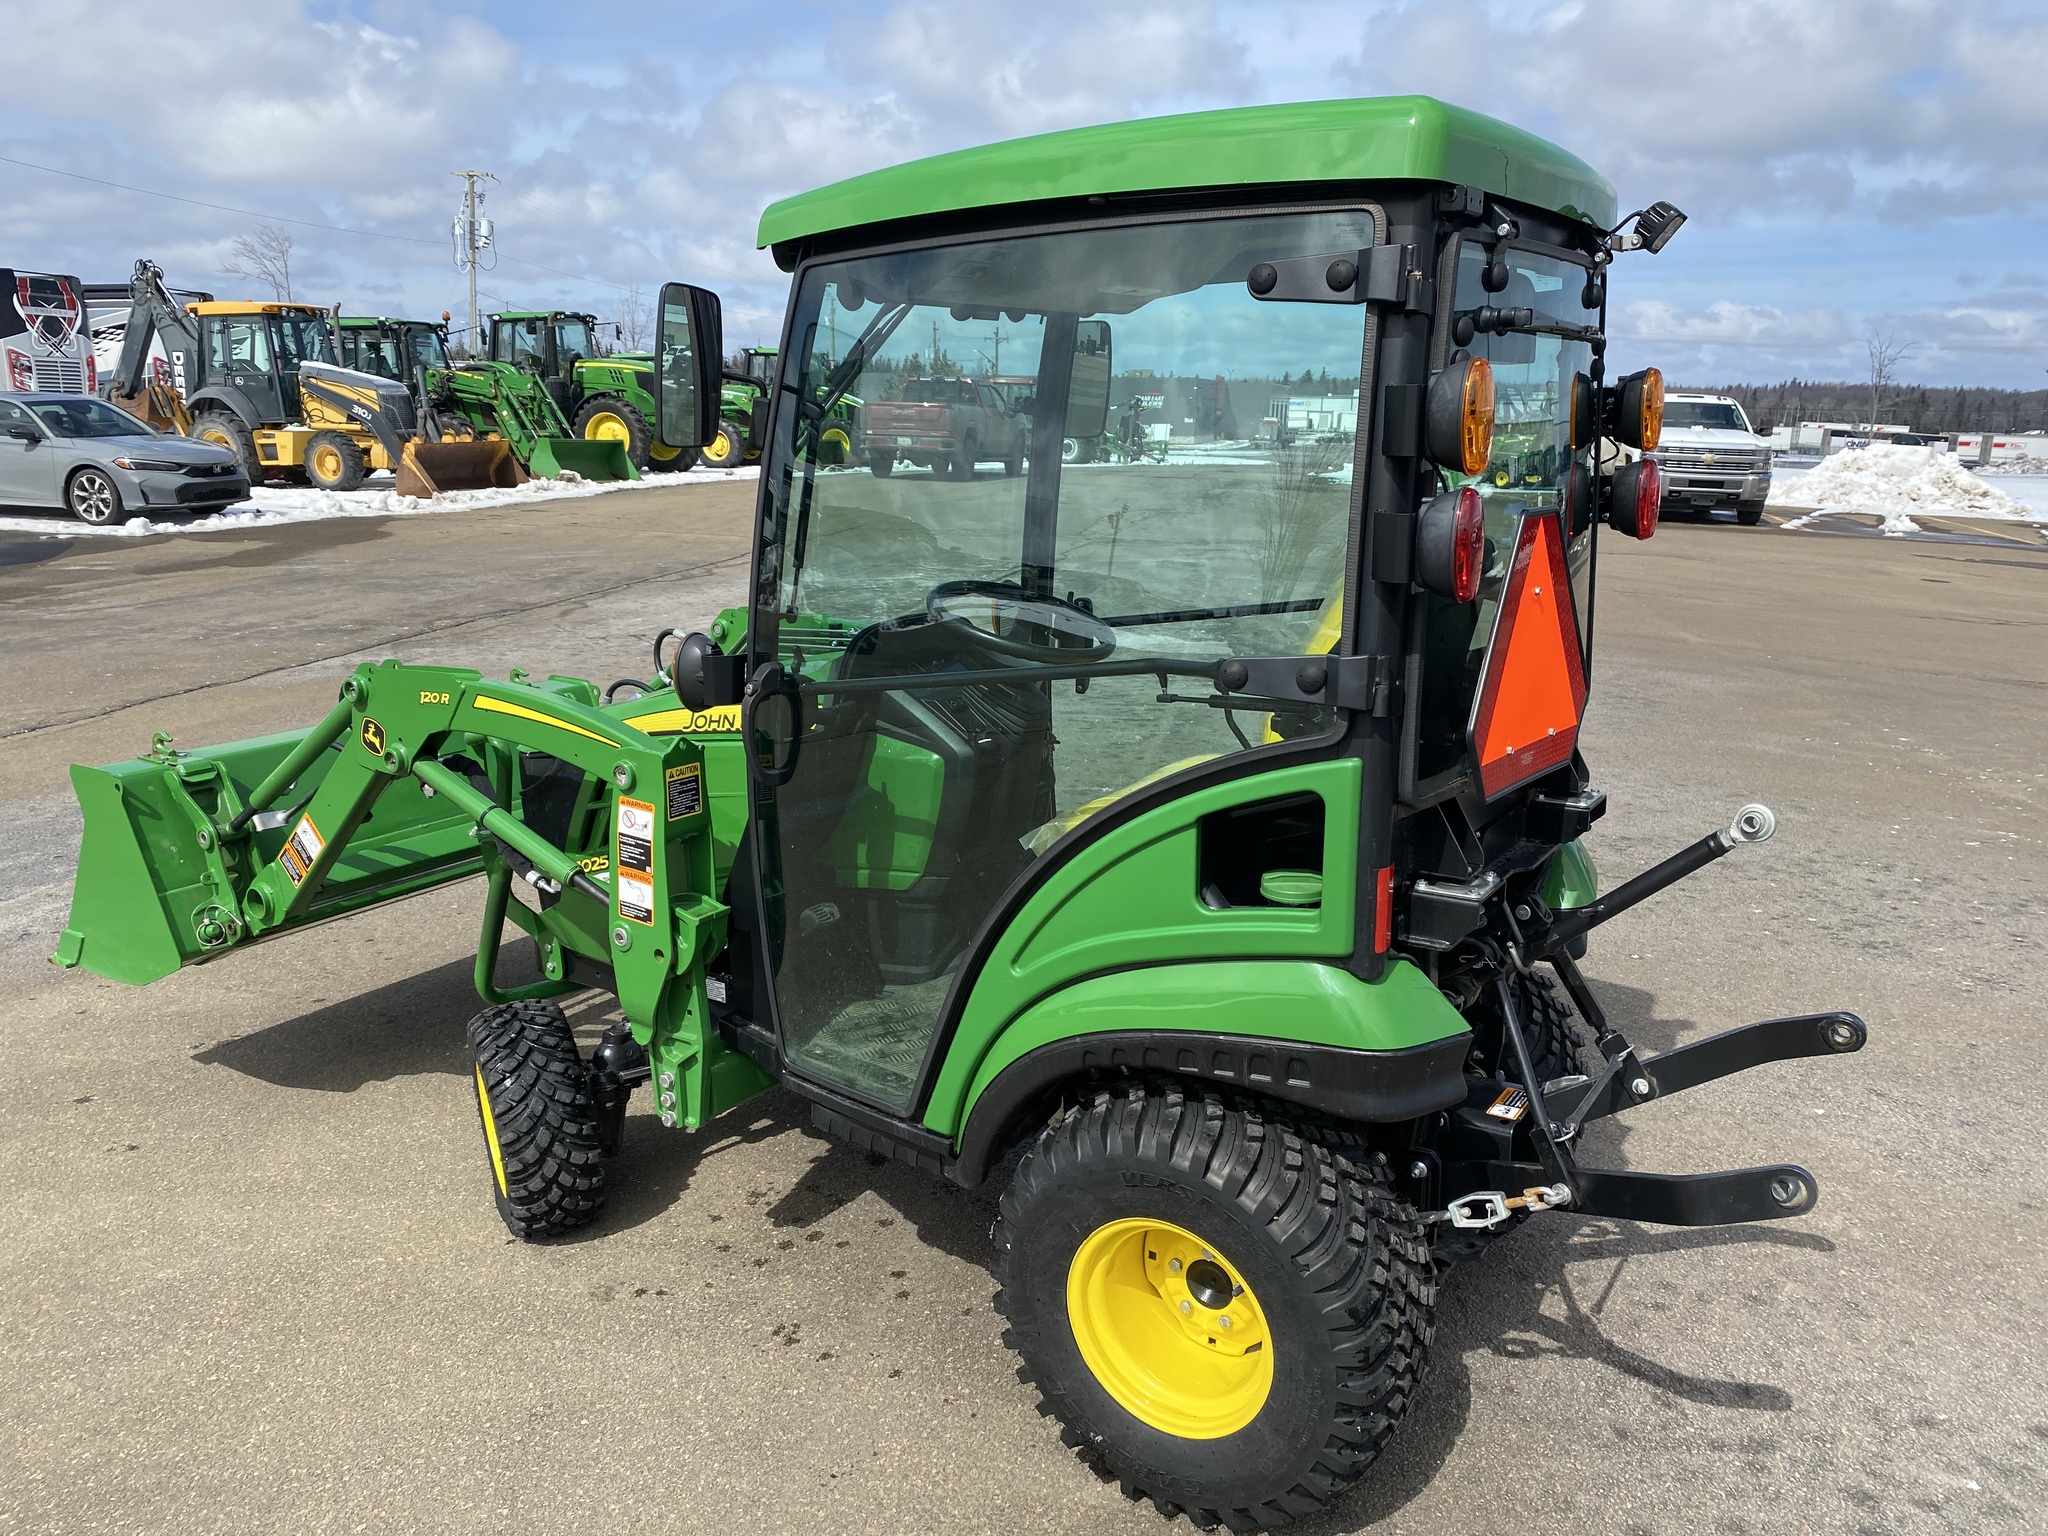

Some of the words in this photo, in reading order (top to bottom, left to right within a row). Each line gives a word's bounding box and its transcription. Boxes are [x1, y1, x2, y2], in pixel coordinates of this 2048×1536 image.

[682, 712, 736, 730] JOHN
[676, 764, 699, 777] CAUTION
[626, 800, 653, 812] WARNING
[624, 871, 652, 884] WARNING
